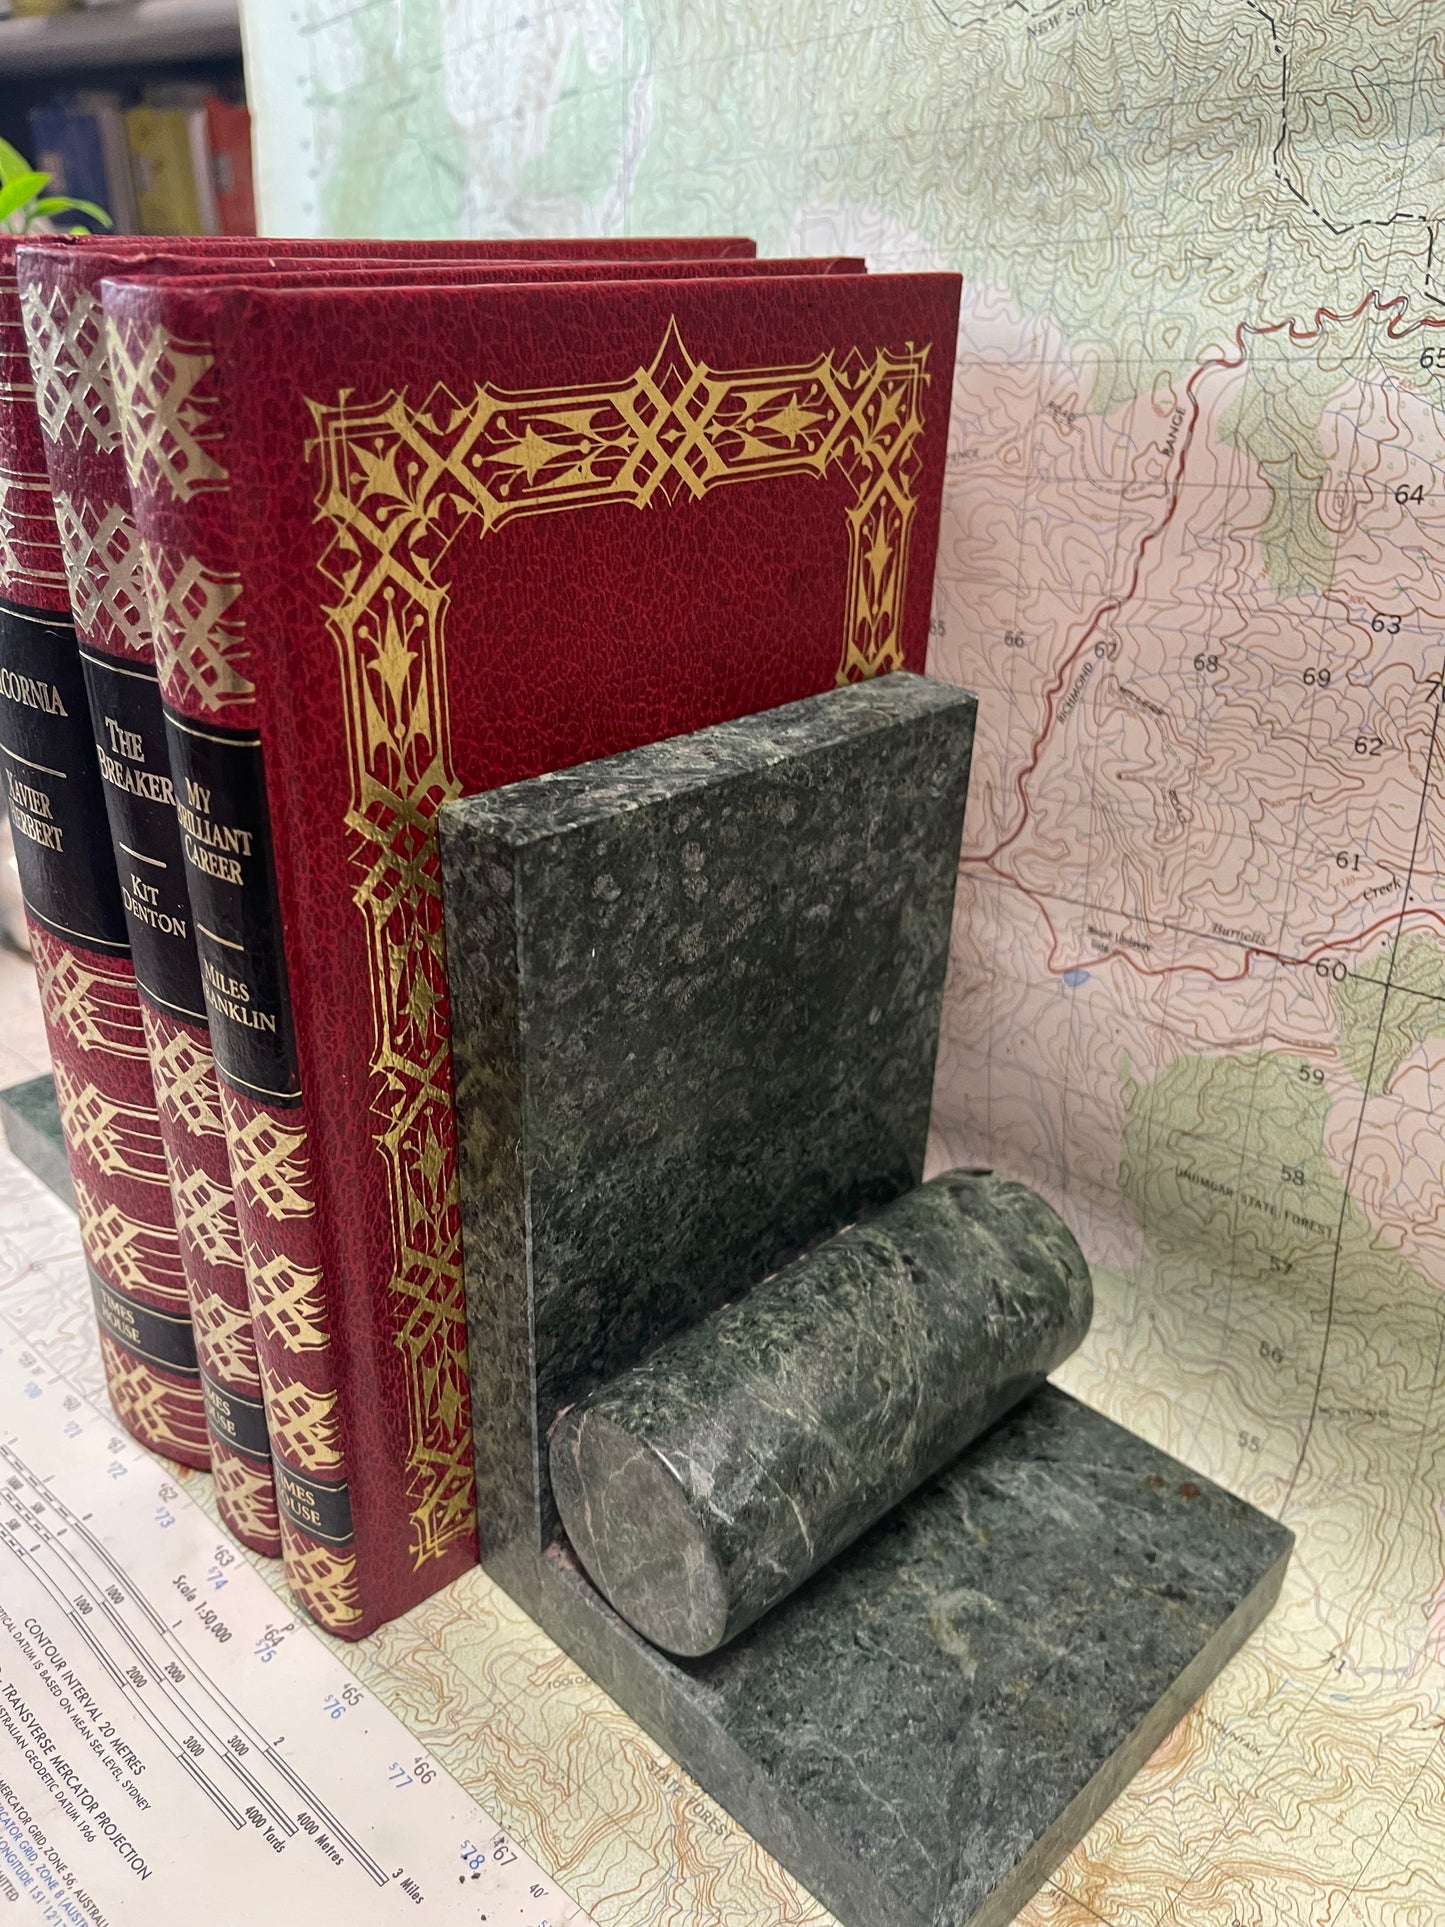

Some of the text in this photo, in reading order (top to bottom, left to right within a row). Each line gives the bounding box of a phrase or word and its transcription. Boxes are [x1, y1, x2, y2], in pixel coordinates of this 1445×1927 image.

[1161, 406, 1186, 457] RANGE
[1394, 484, 1424, 505] 64
[1004, 630, 1025, 648] 66
[1371, 613, 1402, 635] 63
[1193, 653, 1219, 674] 68
[1303, 666, 1331, 688] 69
[105, 715, 146, 764] THE
[1354, 736, 1384, 757] 62
[96, 743, 177, 807] BREAKER
[184, 776, 212, 815] MY
[184, 833, 245, 887] CAREER
[1335, 851, 1361, 872] 61
[121, 885, 188, 940] DENTON
[130, 872, 160, 907] KIT
[1363, 878, 1402, 901] Creek
[203, 957, 251, 1003] MILES
[1315, 957, 1348, 982] 60
[1298, 1065, 1325, 1085] 59
[1279, 1163, 1306, 1187] 58
[1284, 1209, 1333, 1239] FOREST
[173, 1574, 233, 1643] Scale 1:50,000
[12, 1631, 37, 1661] DATUM
[33, 1659, 44, 1671] IS
[39, 1669, 63, 1698] BASED
[59, 1697, 75, 1714] ON
[70, 1713, 93, 1741] MEAN
[89, 1738, 106, 1758] SEA
[101, 1755, 124, 1782] LEVEL,
[121, 1779, 152, 1812] SYDNEY
[24, 1618, 147, 1776] CONTOUR INTERVAL 20 METRES
[73, 1594, 94, 1616] 1000
[126, 1665, 148, 1688] 2000
[182, 1735, 205, 1757] 3000
[245, 1805, 267, 1829] 4000
[262, 1825, 286, 1853] Yards
[104, 1583, 125, 1605] 1000
[164, 1661, 186, 1684] 2000
[227, 1735, 250, 1757] 3000
[296, 1812, 320, 1836] 4000
[314, 1832, 344, 1866] Metres
[0, 1703, 96, 1844] STRALIAN GEODETIC DATUM 1966
[2, 1682, 153, 1882] TRANSVERSE MERCATOR PROJECTION
[274, 1736, 286, 1747] 2
[392, 1867, 404, 1879] 3
[399, 1877, 424, 1905] Miles
[646, 1760, 736, 1841] STATE FOREST
[0, 1802, 24, 1842] RCATOR
[19, 1839, 39, 1867] GRID,
[35, 1863, 60, 1891] ZONE
[54, 1889, 65, 1899] 8
[28, 1824, 47, 1851] GRID,
[43, 1846, 68, 1874] ZONE
[62, 1872, 78, 1890] 56,
